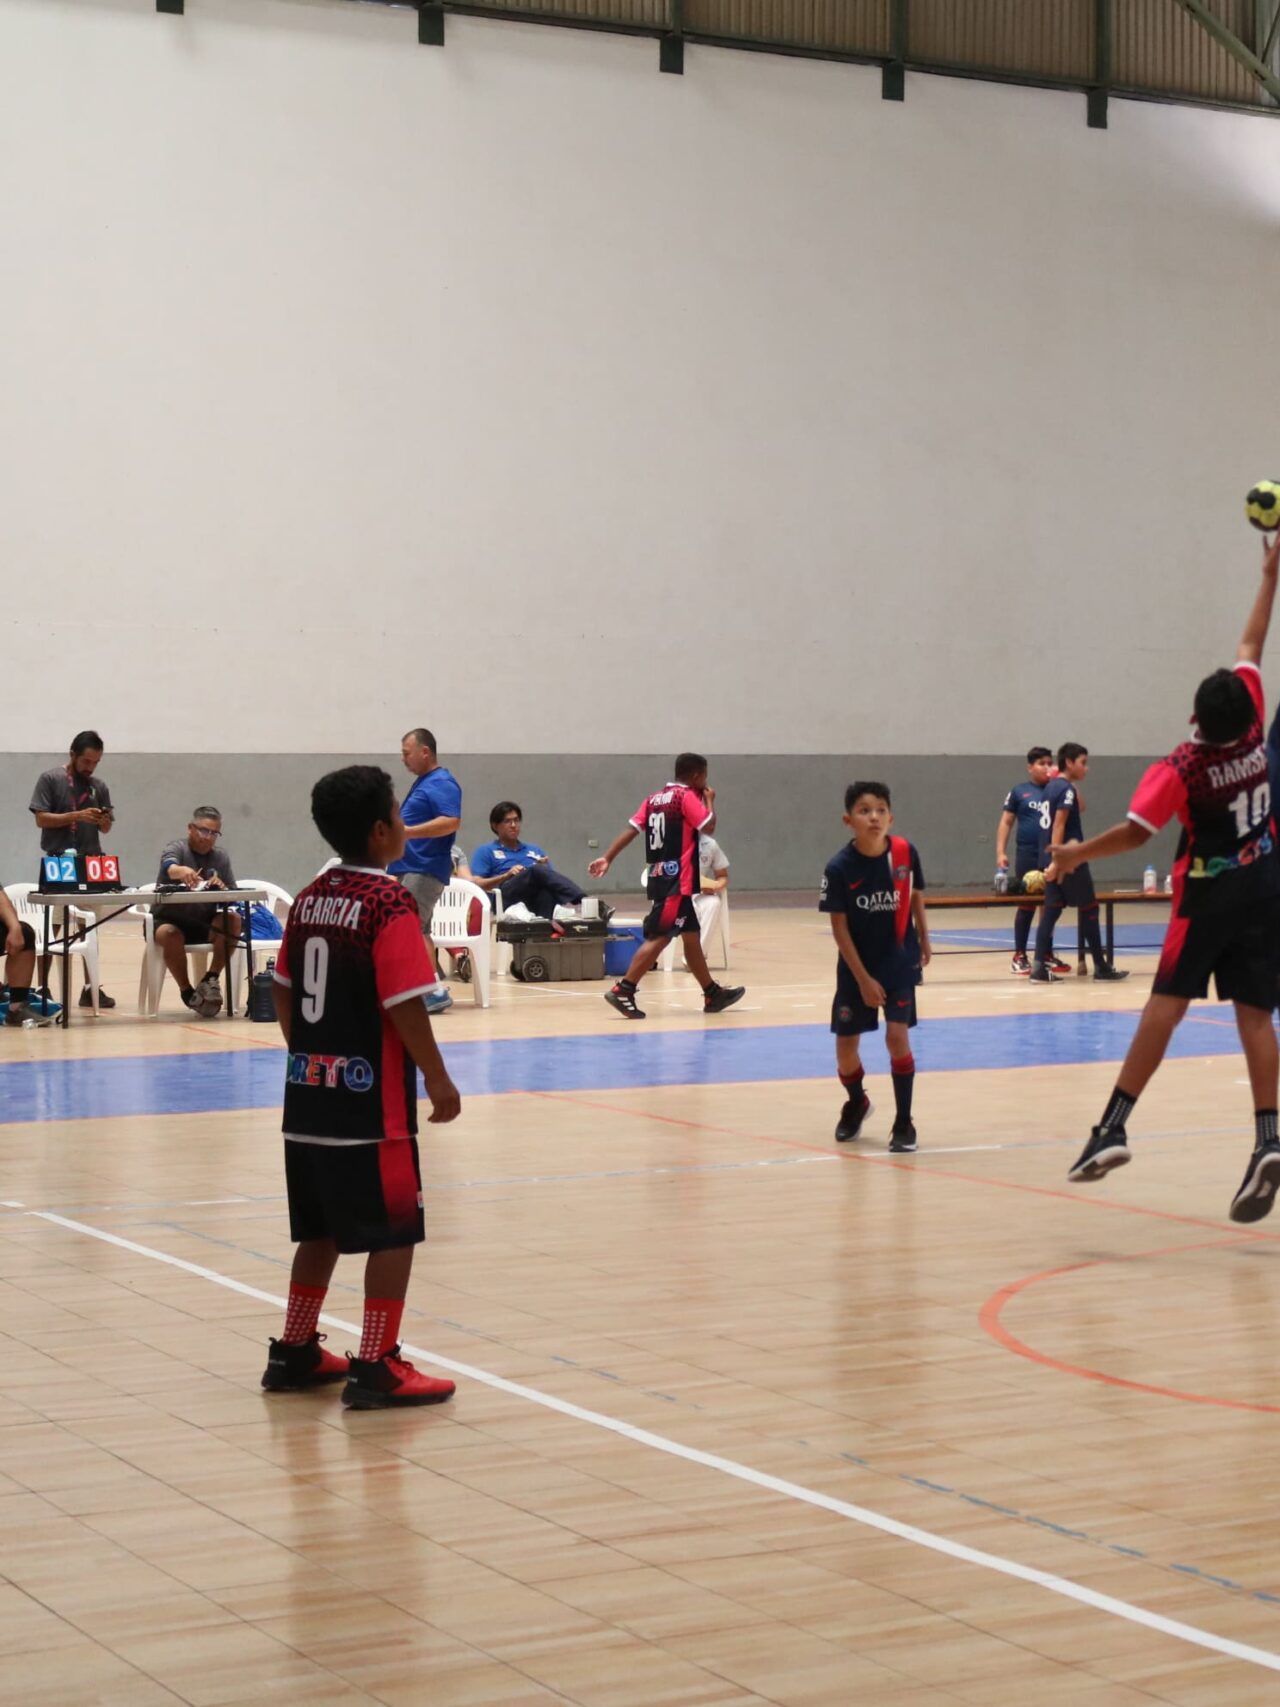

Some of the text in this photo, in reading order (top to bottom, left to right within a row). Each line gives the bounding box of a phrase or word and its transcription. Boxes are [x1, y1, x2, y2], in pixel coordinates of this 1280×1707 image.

[1040, 800, 1051, 829] 8
[1228, 782, 1271, 838] 10
[648, 811, 666, 851] 30
[46, 861, 76, 880] 02
[88, 860, 117, 880] 03
[301, 896, 362, 930] GARCIA
[856, 890, 901, 910] QATAR
[301, 936, 329, 1024] 9
[287, 1053, 374, 1092] RETO
